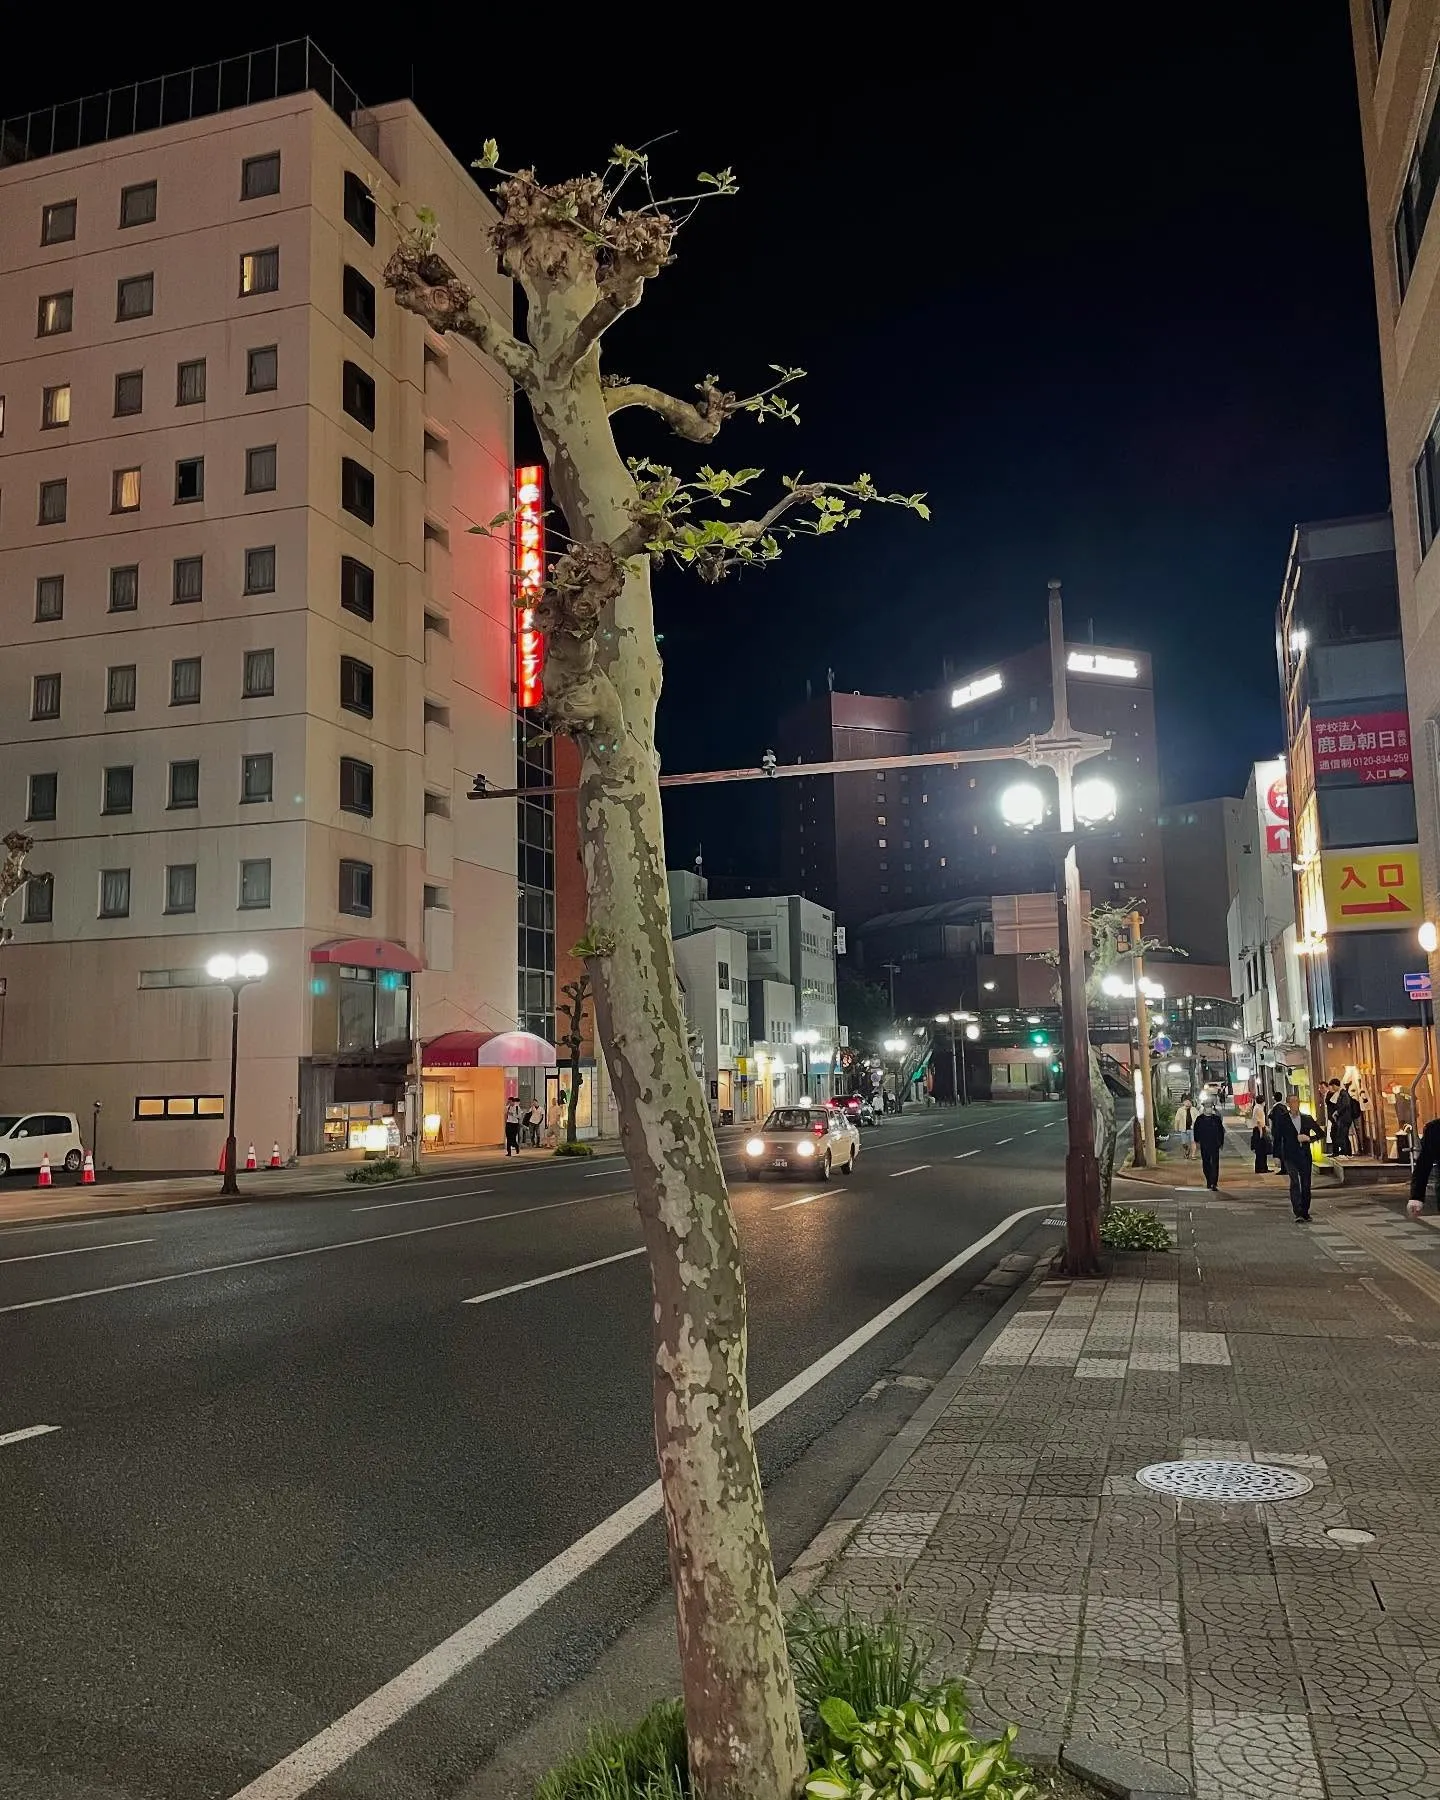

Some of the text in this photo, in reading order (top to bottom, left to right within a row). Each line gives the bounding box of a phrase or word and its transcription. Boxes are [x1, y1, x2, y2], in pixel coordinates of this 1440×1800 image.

[1316, 720, 1361, 733] 学校法人
[1320, 753, 1409, 770] 通信制 0120-834-259
[1366, 770, 1386, 780] 入口
[1340, 864, 1404, 890] 入口
